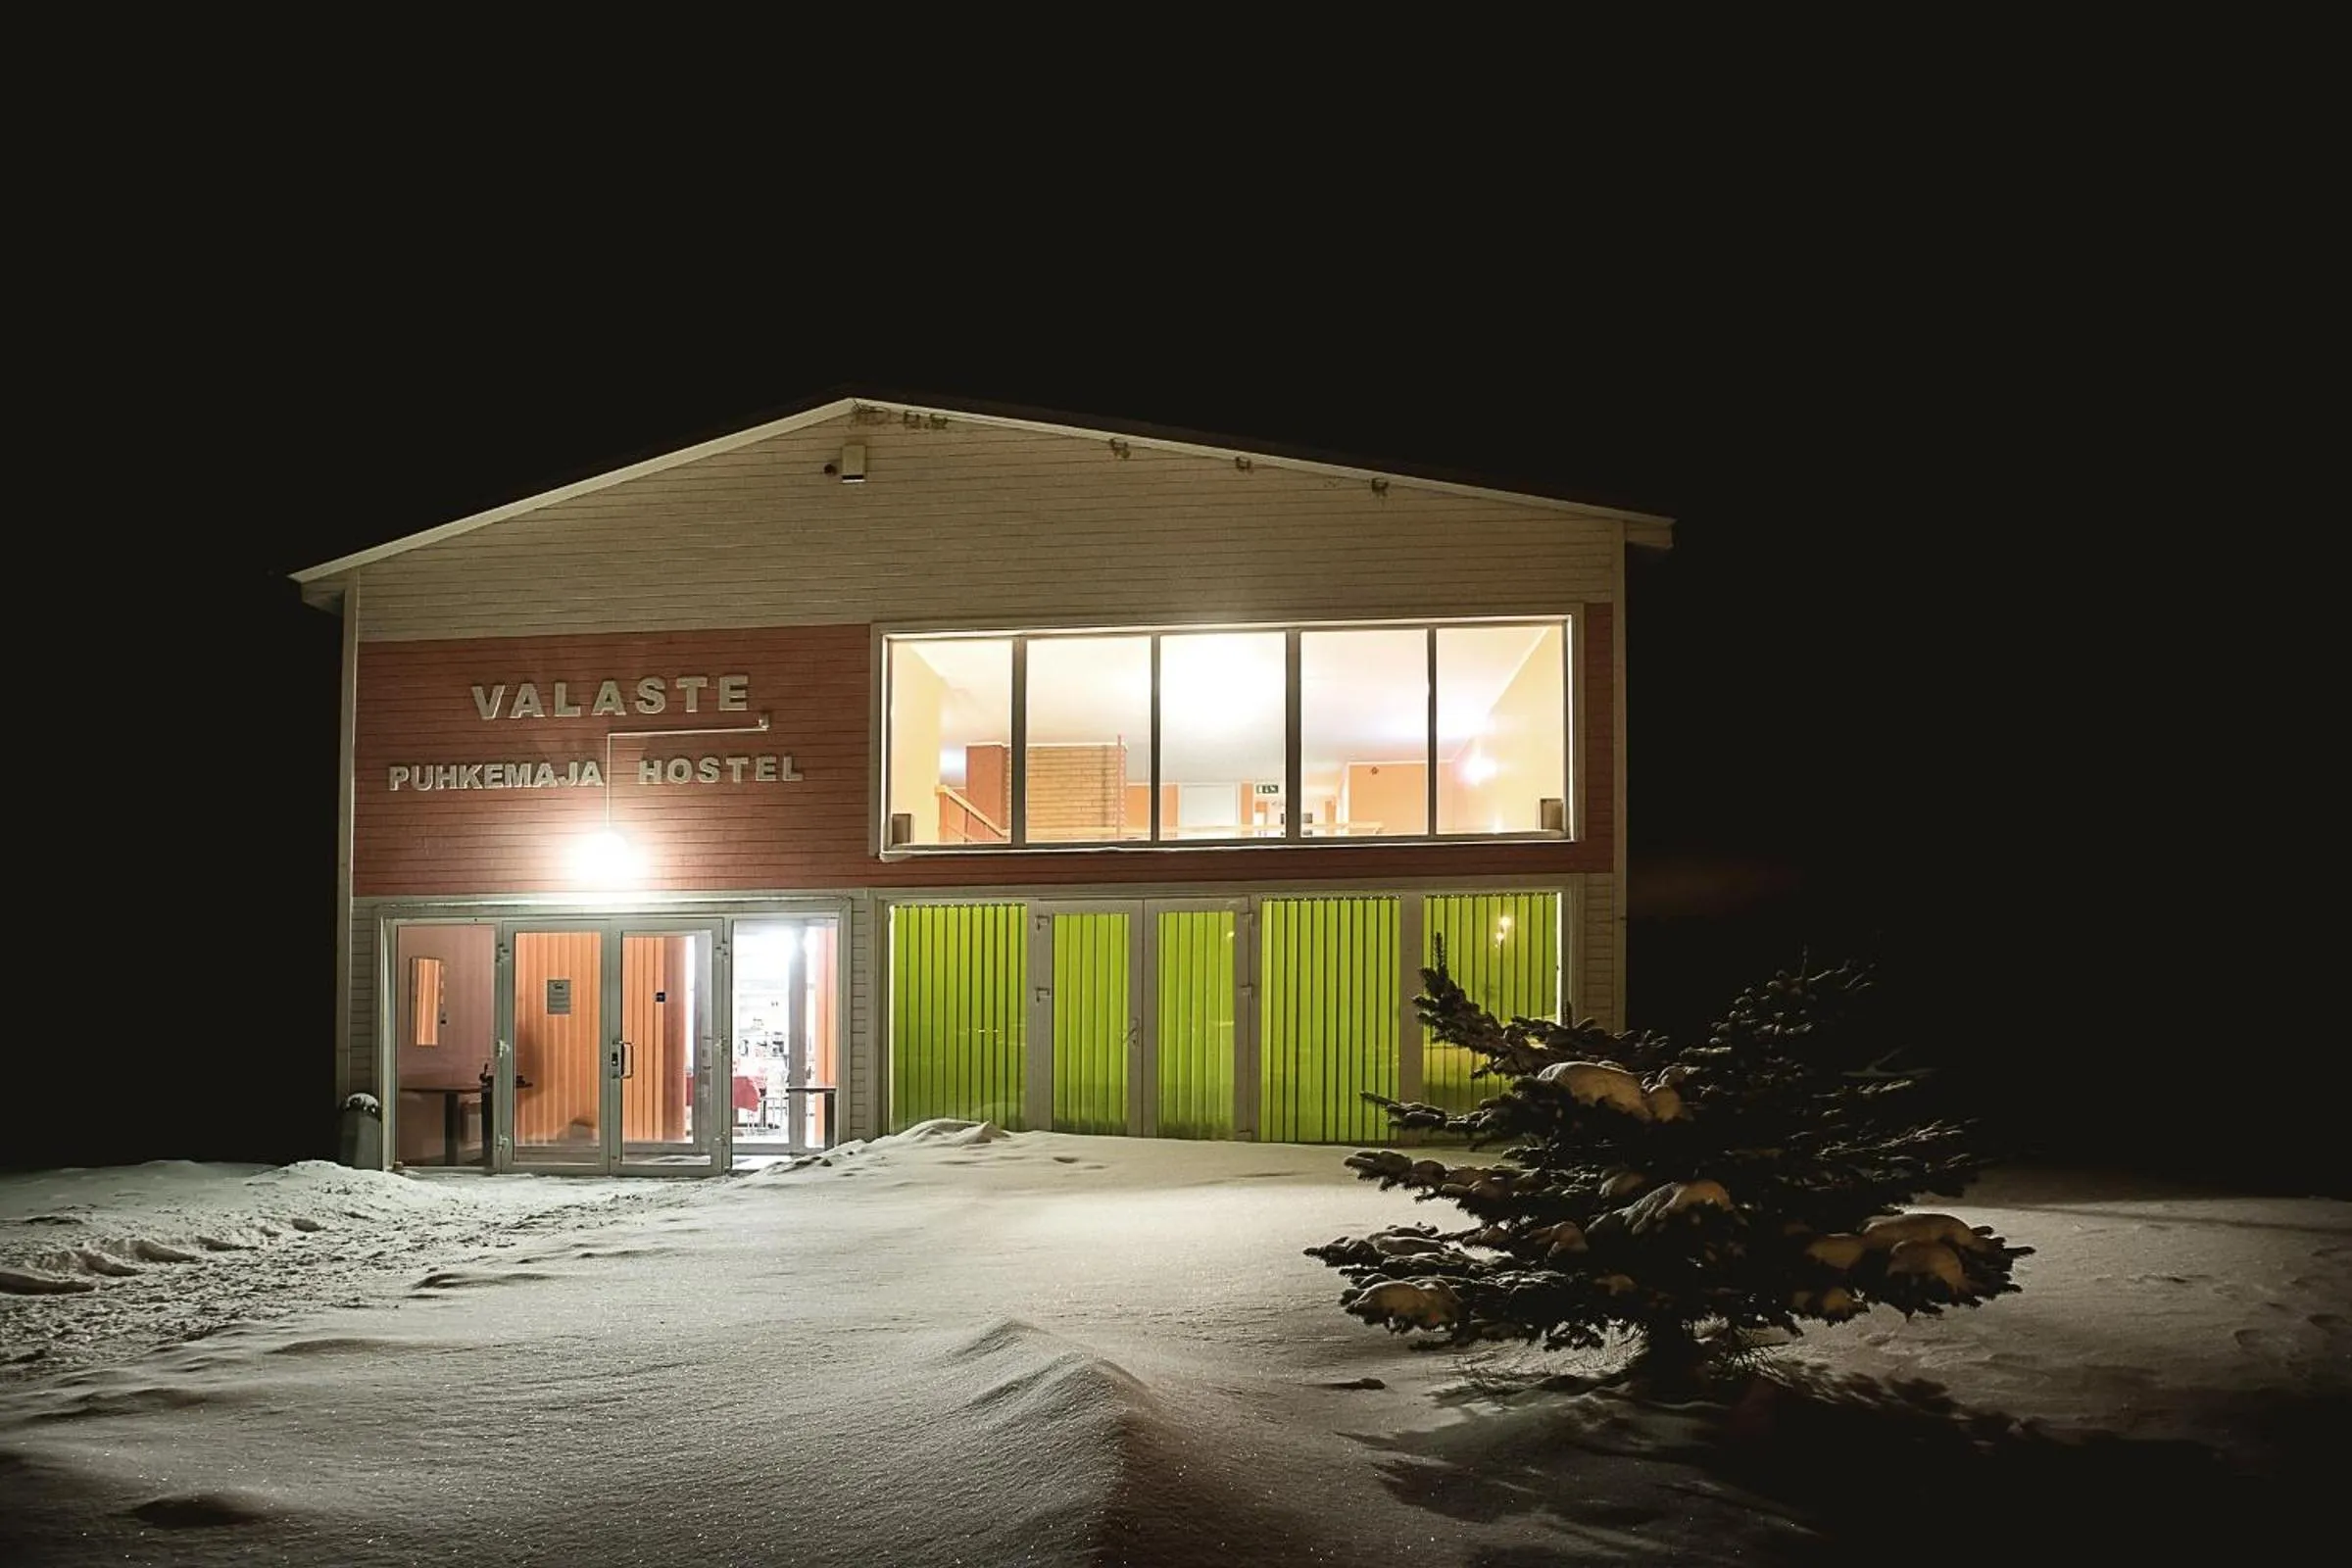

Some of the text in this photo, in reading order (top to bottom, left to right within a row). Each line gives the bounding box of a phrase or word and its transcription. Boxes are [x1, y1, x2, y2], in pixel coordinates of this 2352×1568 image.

[471, 675, 749, 720] VALASTE
[389, 756, 804, 792] PUHKEMAJA HOSTEL
